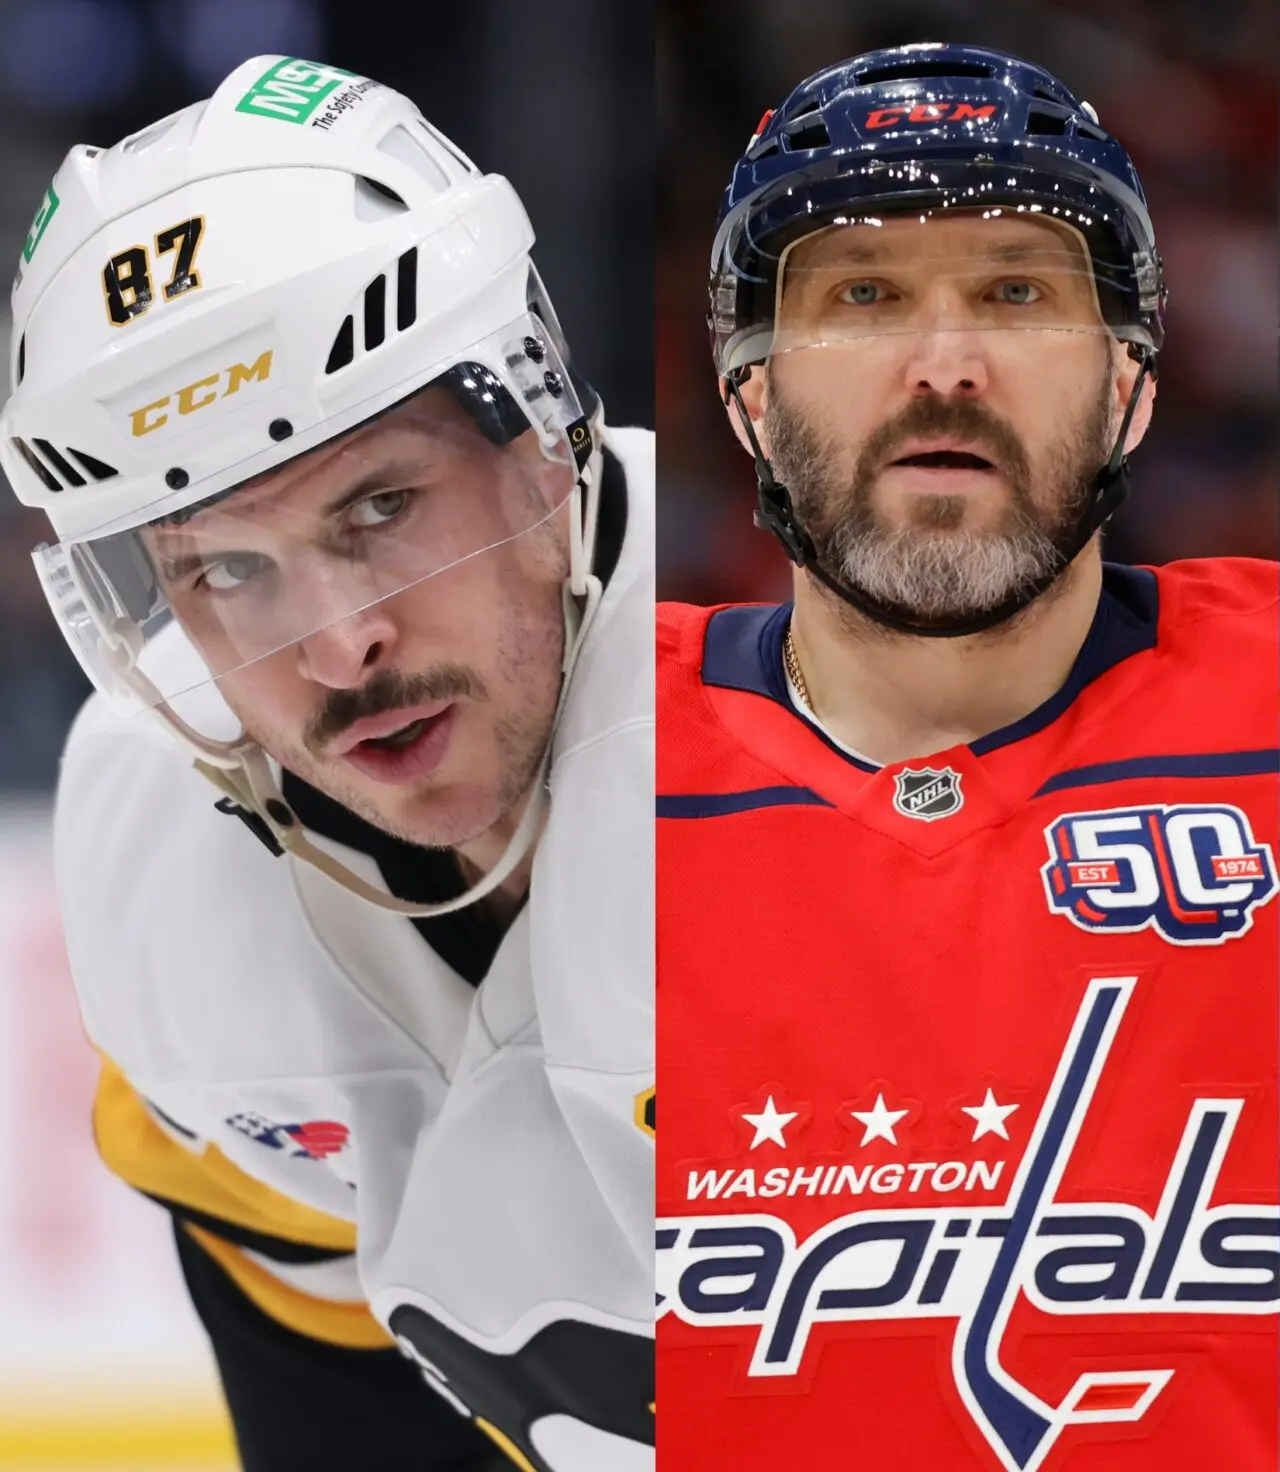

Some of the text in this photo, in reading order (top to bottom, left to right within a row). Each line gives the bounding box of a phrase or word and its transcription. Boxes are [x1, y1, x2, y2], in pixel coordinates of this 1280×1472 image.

[312, 110, 338, 131] The
[327, 90, 363, 115] Safety
[865, 103, 996, 130] CCM
[101, 215, 205, 327] 87
[128, 349, 273, 437] CCM
[909, 781, 949, 810] NHL
[1072, 811, 1254, 909] 50
[1077, 867, 1109, 881] EST
[1217, 860, 1259, 874] 1974
[686, 1160, 1006, 1200] WASHINGTON
[655, 977, 1280, 1472] apitals
